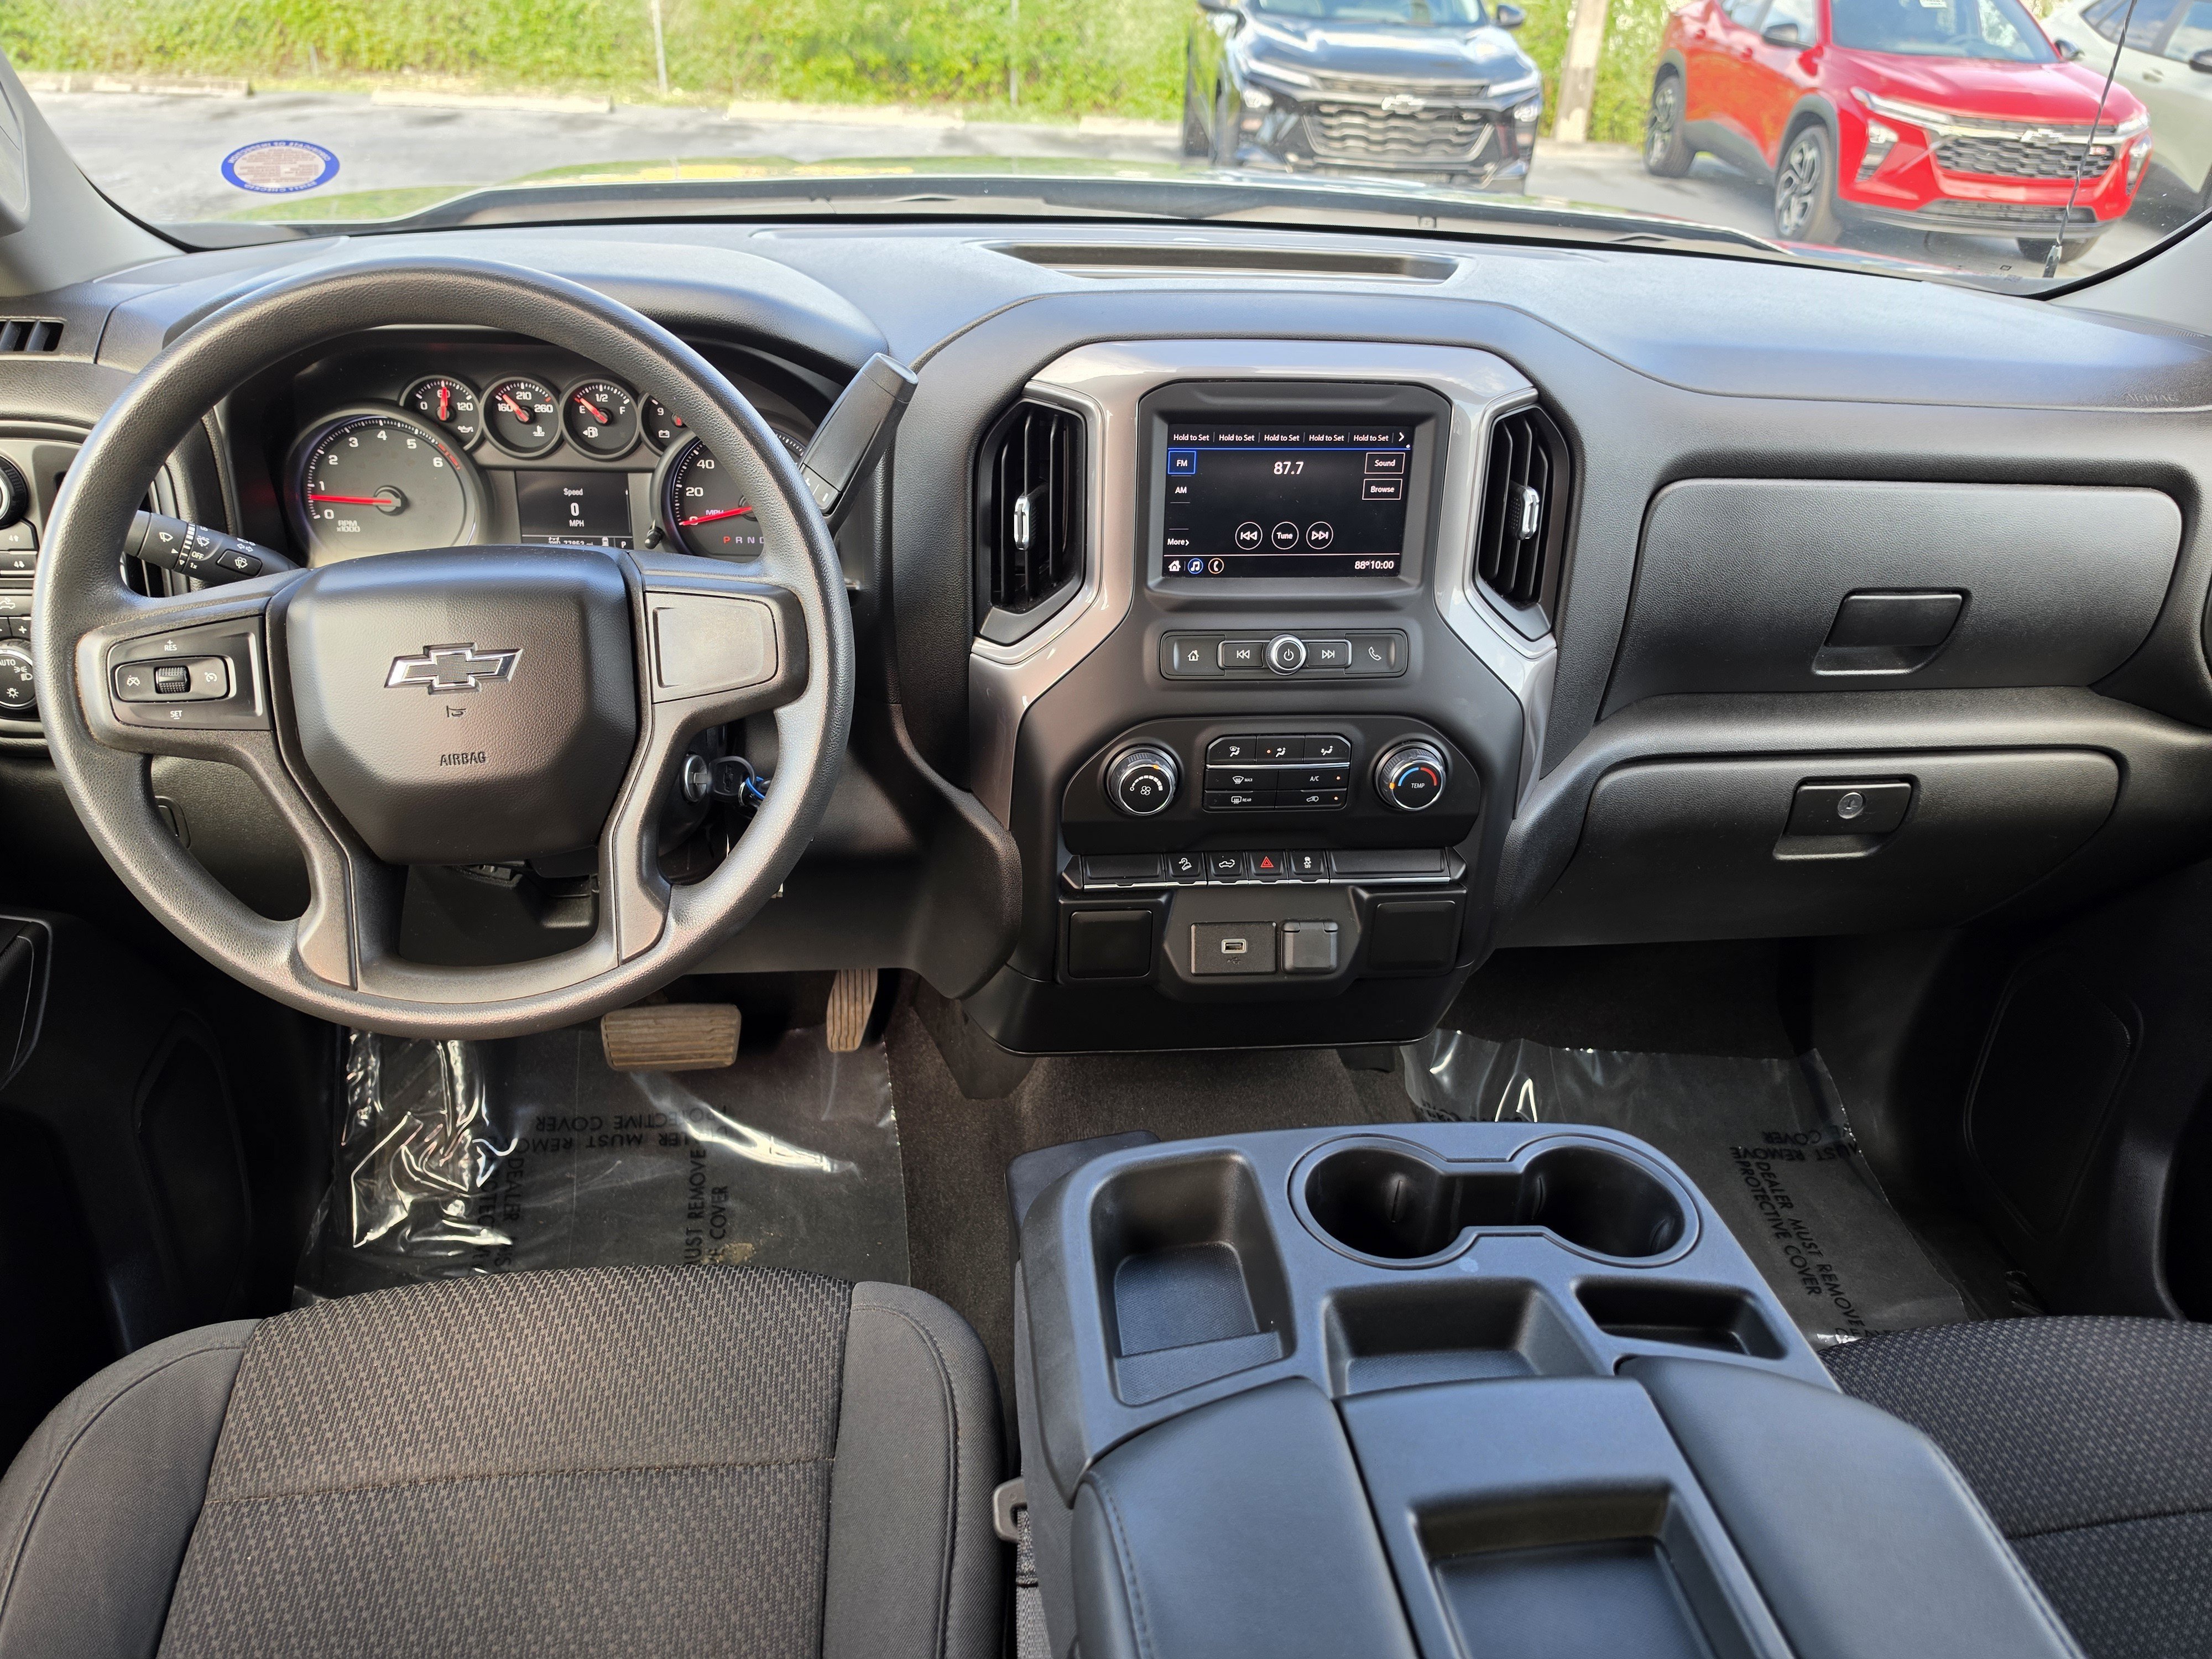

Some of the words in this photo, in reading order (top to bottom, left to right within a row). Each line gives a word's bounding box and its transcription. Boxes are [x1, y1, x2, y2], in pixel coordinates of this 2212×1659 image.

[516, 391, 531, 400] 210
[596, 393, 608, 402] 1/2
[420, 401, 427, 410] 0
[457, 402, 473, 411] 120
[497, 403, 513, 412] 160
[534, 404, 554, 413] 260
[579, 405, 585, 414] E
[377, 430, 387, 441] 4
[348, 437, 358, 447] 3
[406, 439, 417, 449] 5
[328, 455, 338, 465] 2
[432, 457, 443, 467] 6
[697, 460, 714, 469] 40
[1274, 461, 1304, 474] 87.7
[319, 481, 325, 491] 1
[564, 488, 583, 497] Speed
[686, 487, 703, 497] 20
[324, 509, 334, 519] 0
[570, 503, 580, 517] 0
[191, 551, 204, 560] OFF
[1370, 561, 1394, 569] 10:00
[440, 752, 487, 766] AIRBAG
[535, 1115, 603, 1133] COVER
[586, 1134, 643, 1149] MUST
[687, 1149, 706, 1219] REMOVE
[709, 1186, 728, 1240] COVER
[1736, 1161, 1792, 1239] PROTECTIVE
[1784, 1245, 1822, 1295] COVER
[1755, 1162, 1794, 1209] DEALER
[1787, 1218, 1823, 1258] MUST
[1816, 1264, 1865, 1327] REMOVE
